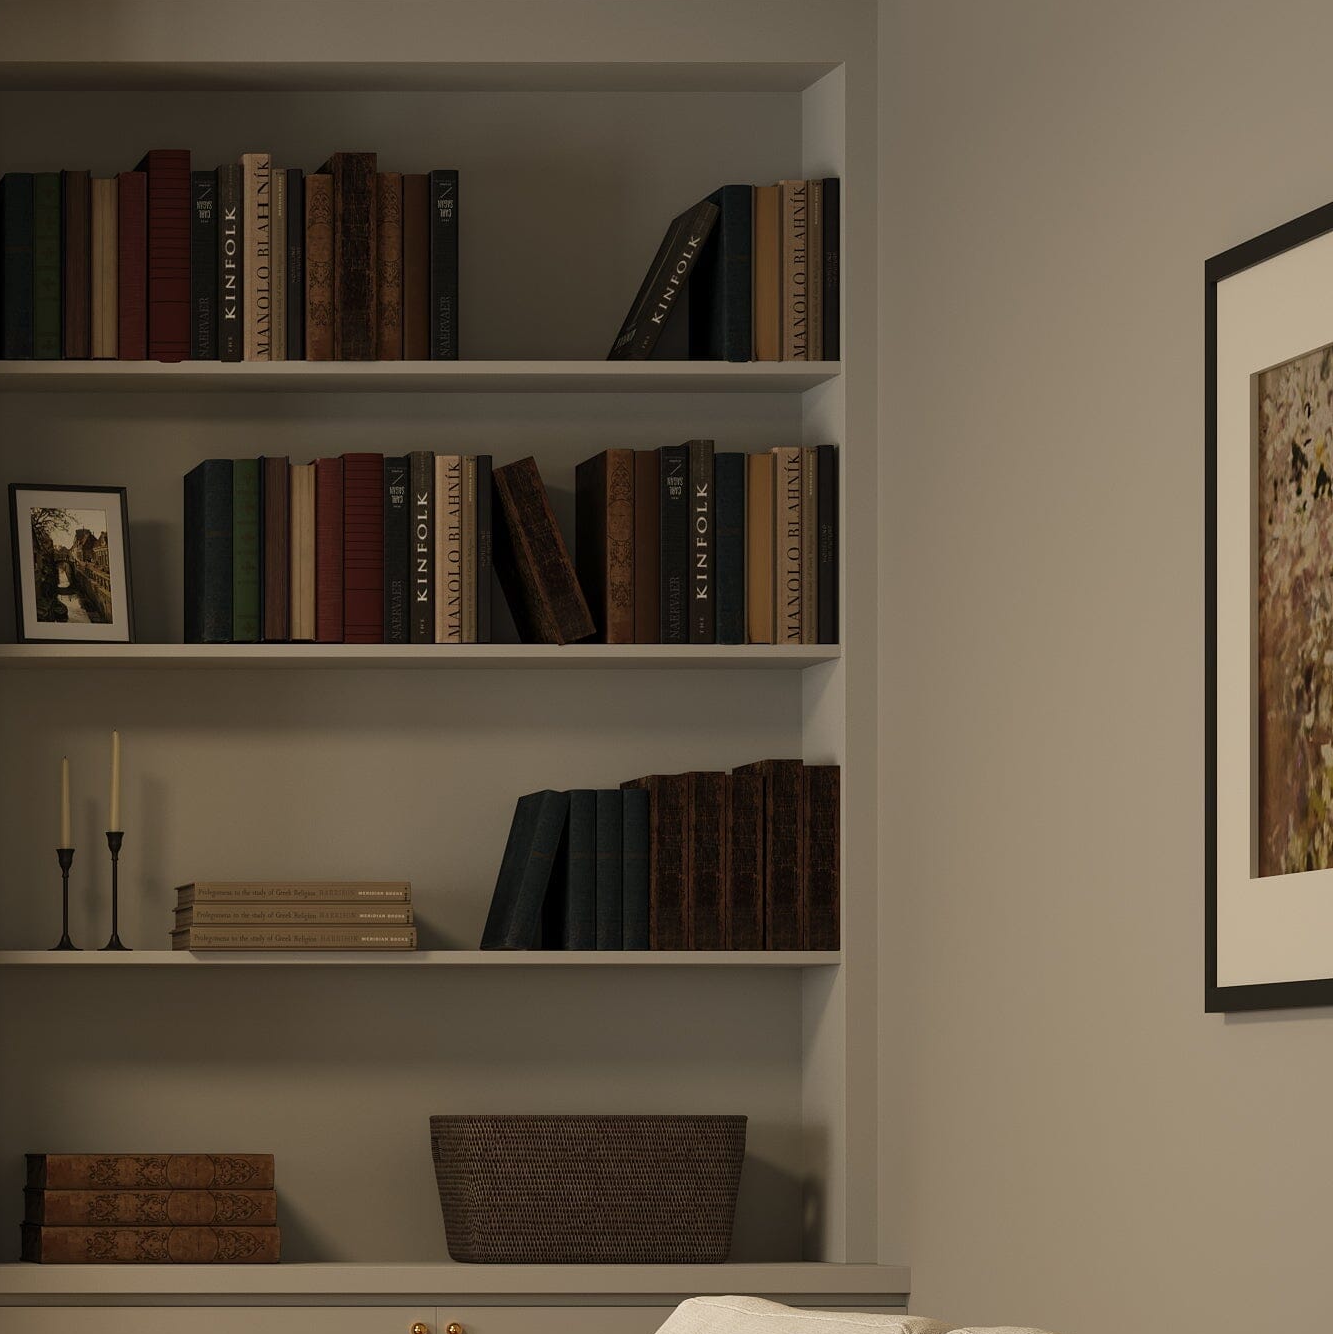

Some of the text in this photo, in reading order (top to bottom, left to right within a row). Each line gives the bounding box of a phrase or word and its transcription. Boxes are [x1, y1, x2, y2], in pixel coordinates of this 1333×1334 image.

[225, 207, 236, 319] KINFOLK
[253, 161, 269, 355] MANOLO BLAHNÍK
[652, 235, 702, 325] KINFOLK
[790, 187, 806, 357] MANOLO BLAHNÍK
[417, 492, 428, 602] KINFOLK
[445, 462, 460, 637] MANOLO BLAHNÍK
[697, 483, 708, 599] KINFOLK
[784, 454, 801, 638] MANOLO BLAHNÍK
